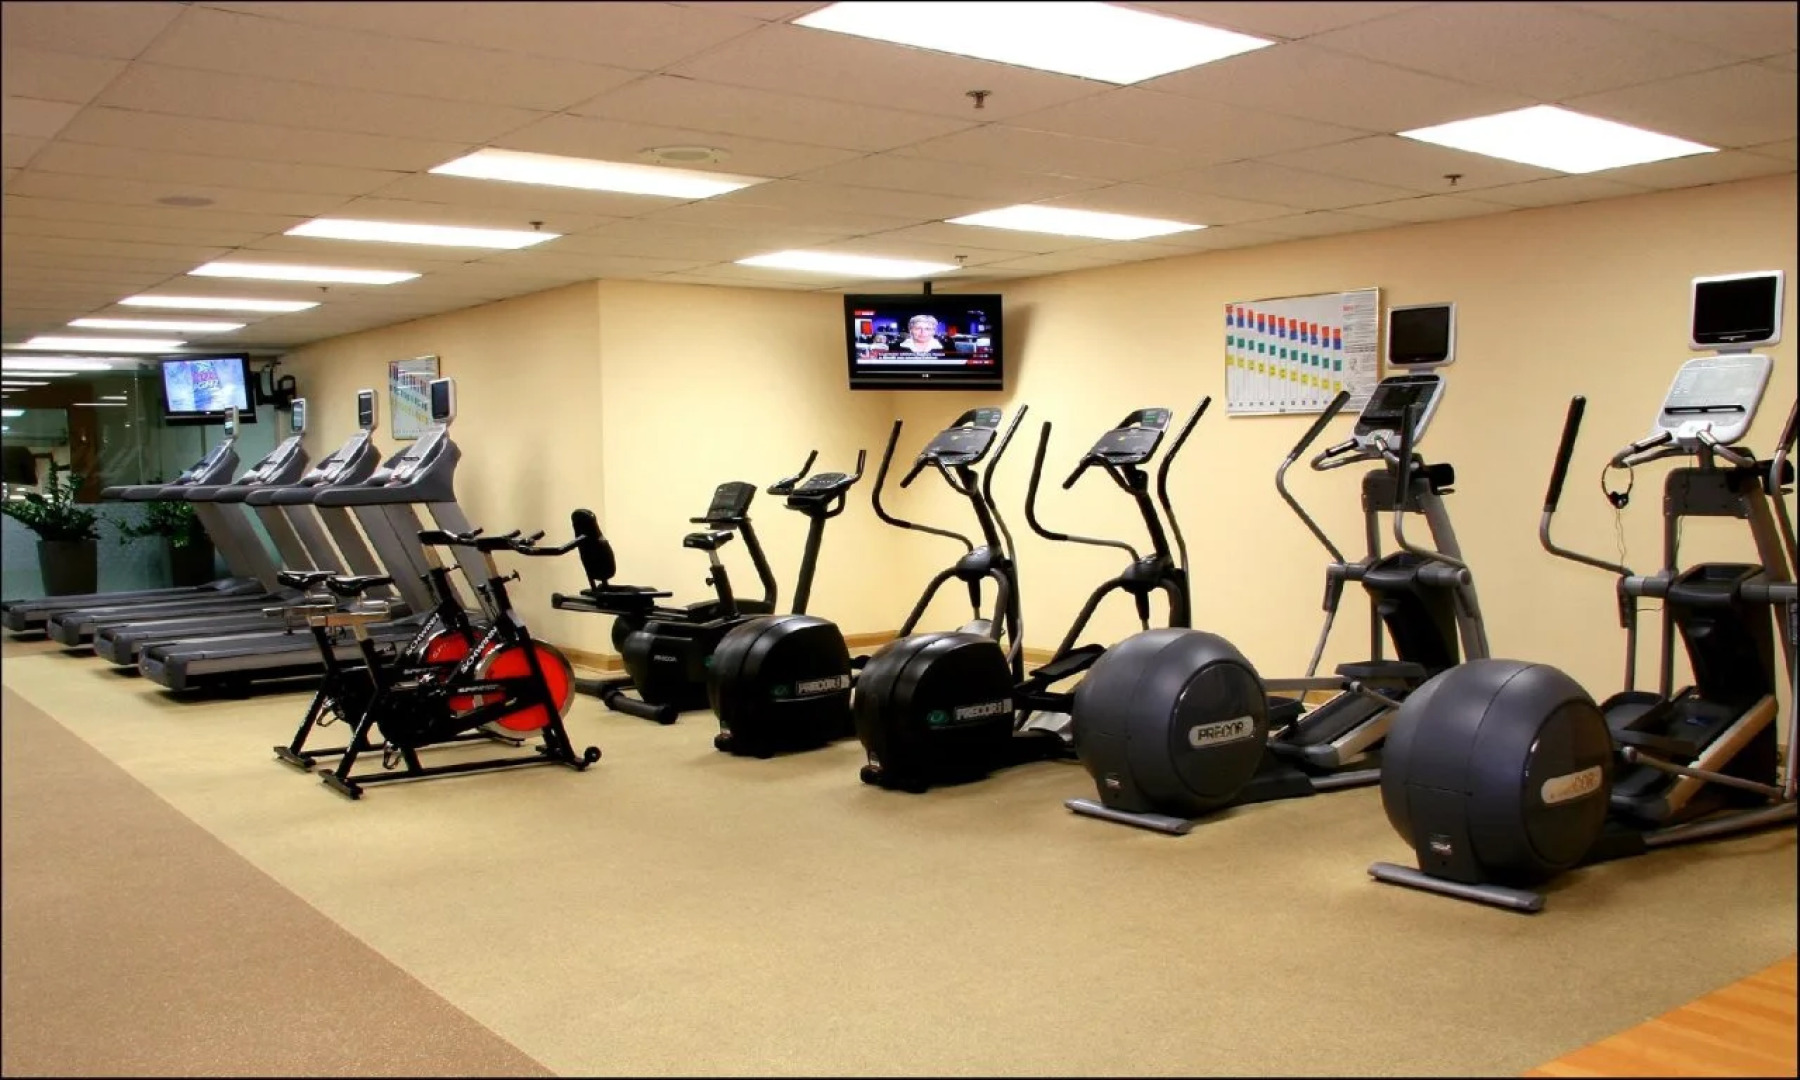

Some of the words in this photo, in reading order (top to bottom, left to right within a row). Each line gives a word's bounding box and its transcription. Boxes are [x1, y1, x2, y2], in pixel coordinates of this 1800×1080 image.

[460, 625, 498, 674] SCHWINN
[798, 676, 839, 695] PRECOR
[955, 702, 1001, 721] PRECOR
[1197, 721, 1243, 741] PRECOR
